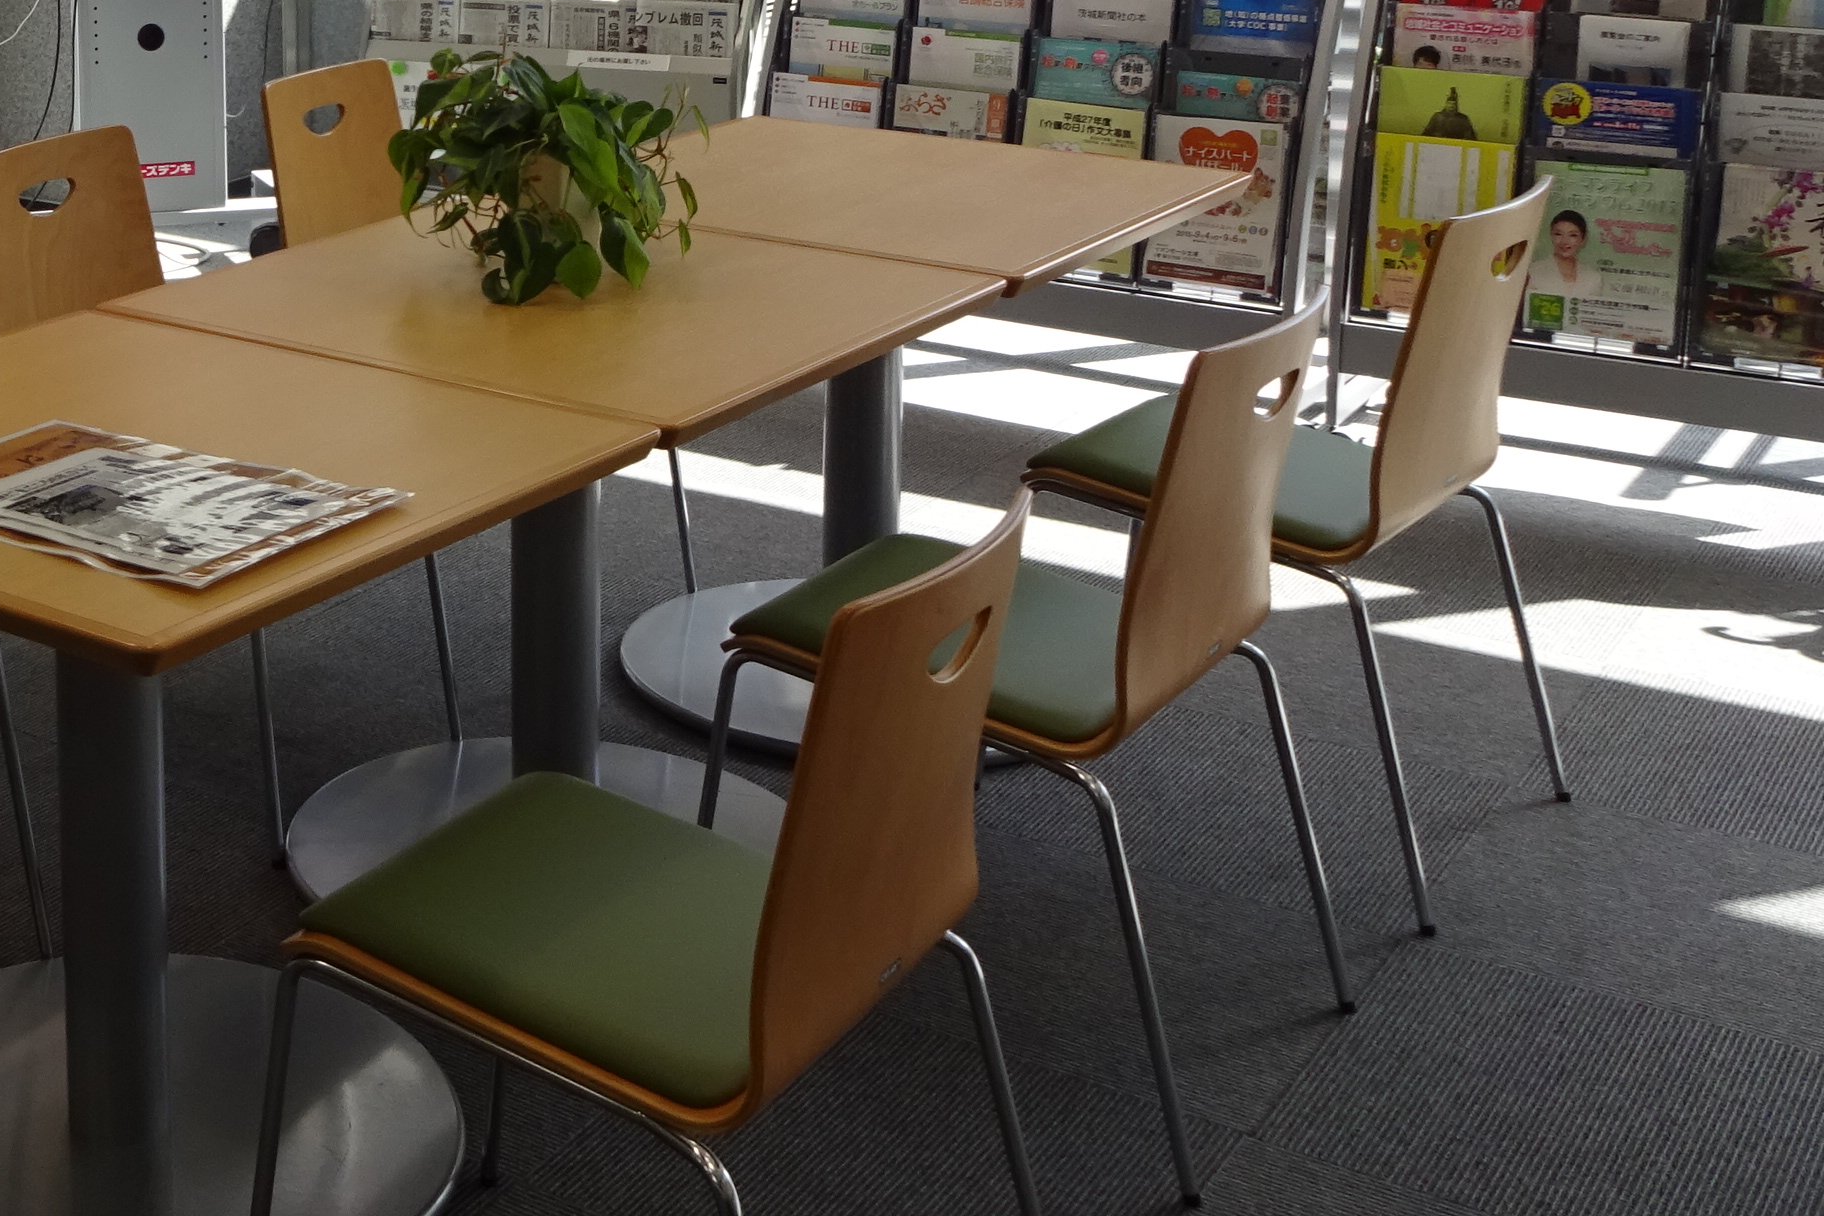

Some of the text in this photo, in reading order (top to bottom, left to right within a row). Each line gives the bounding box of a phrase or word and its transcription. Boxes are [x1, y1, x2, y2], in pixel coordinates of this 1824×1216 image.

[1077, 8, 1147, 23] 茨城新聞社の本
[826, 39, 860, 53] THE
[807, 95, 840, 110] THE
[1062, 112, 1112, 126] 平成27年度
[1184, 146, 1252, 162] ナイスハート
